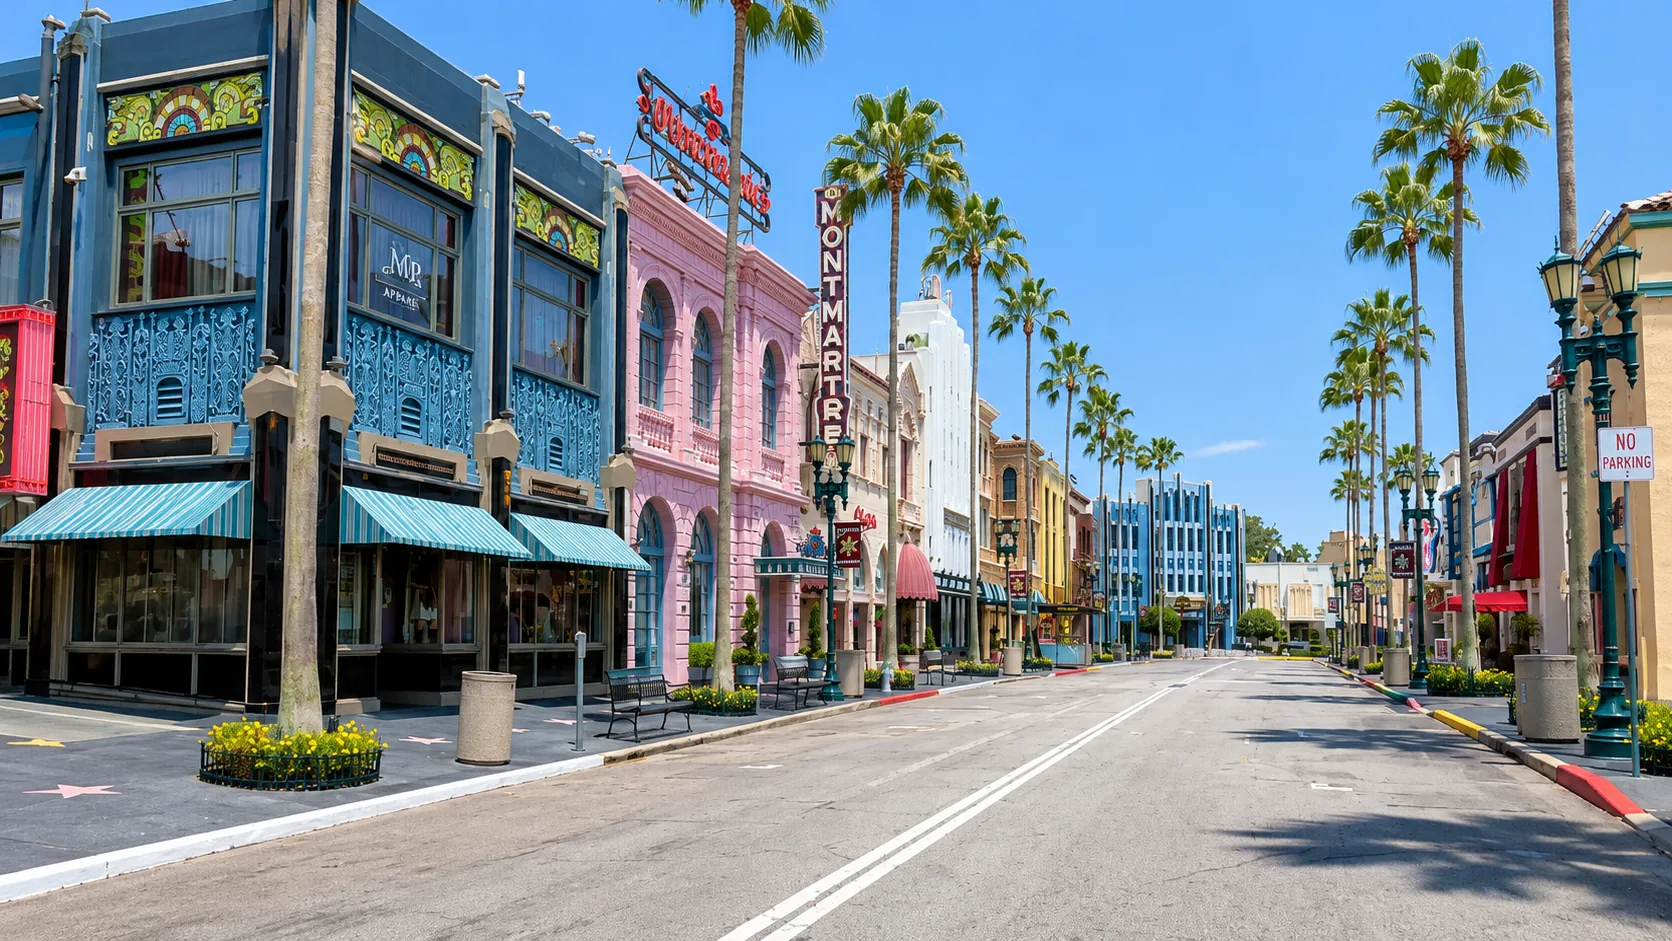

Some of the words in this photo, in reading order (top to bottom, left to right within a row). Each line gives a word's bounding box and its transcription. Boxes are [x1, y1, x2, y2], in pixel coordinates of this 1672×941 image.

[820, 200, 843, 445] MONTMARTRE
[1616, 433, 1636, 450] NO
[1602, 456, 1651, 469] PARKING
